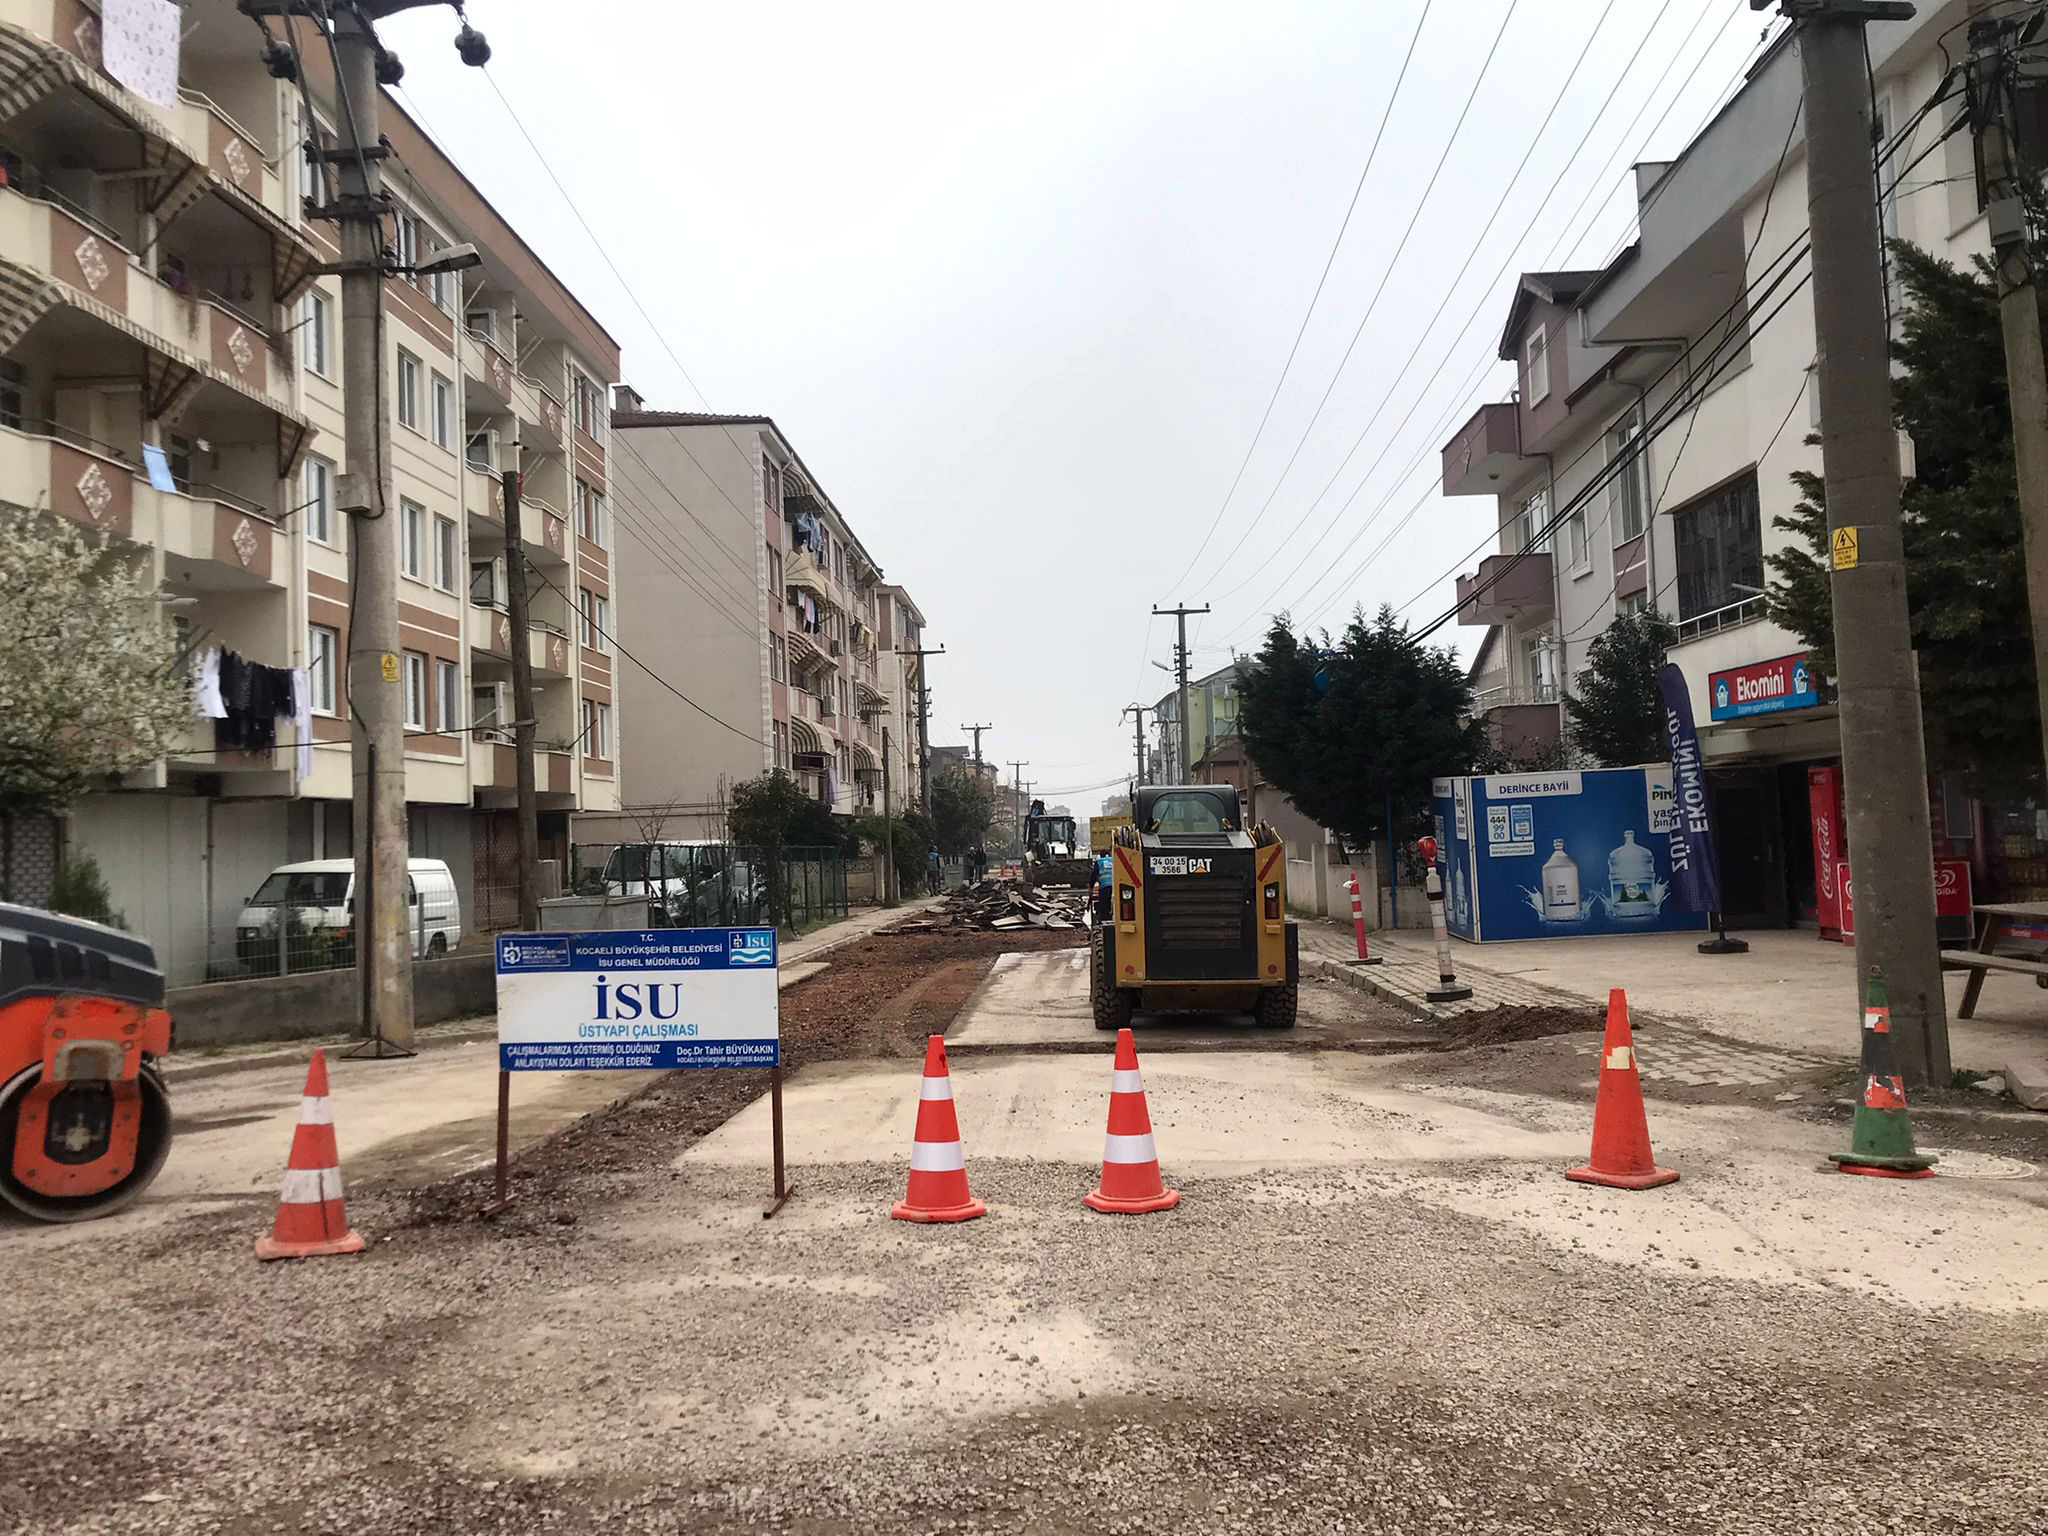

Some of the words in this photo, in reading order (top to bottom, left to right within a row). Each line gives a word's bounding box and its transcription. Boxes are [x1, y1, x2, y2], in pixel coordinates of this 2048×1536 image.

[1736, 666, 1785, 701] Ekomini
[1499, 783, 1541, 794] DERİNCE
[1152, 857, 1162, 865] 34
[1164, 857, 1175, 865] 00
[1176, 857, 1186, 865] 15
[1816, 815, 1833, 900] Coca-Cola
[1188, 858, 1213, 873] CAT
[1936, 887, 1957, 896] GIDA
[640, 933, 656, 942] T.C.
[747, 934, 770, 947] İSU
[575, 946, 614, 955] KOCAELİ
[615, 944, 671, 956] BÜYÜKŞEHİR
[672, 943, 723, 953] BELEDİYESİ
[598, 958, 613, 967] İSU
[614, 958, 644, 967] GENEL
[645, 957, 701, 967] MÜDÜRLÜĞÜ
[592, 975, 683, 1020] İSU
[579, 1023, 629, 1038] ÜSTYAPI
[632, 1023, 699, 1039] ÇALIŞMASI
[704, 1045, 724, 1055] Tahir
[725, 1043, 774, 1055] BÜYÜKAKIN
[559, 1056, 585, 1067] DOLAYI
[586, 1055, 625, 1068] TEŞEKKÜR
